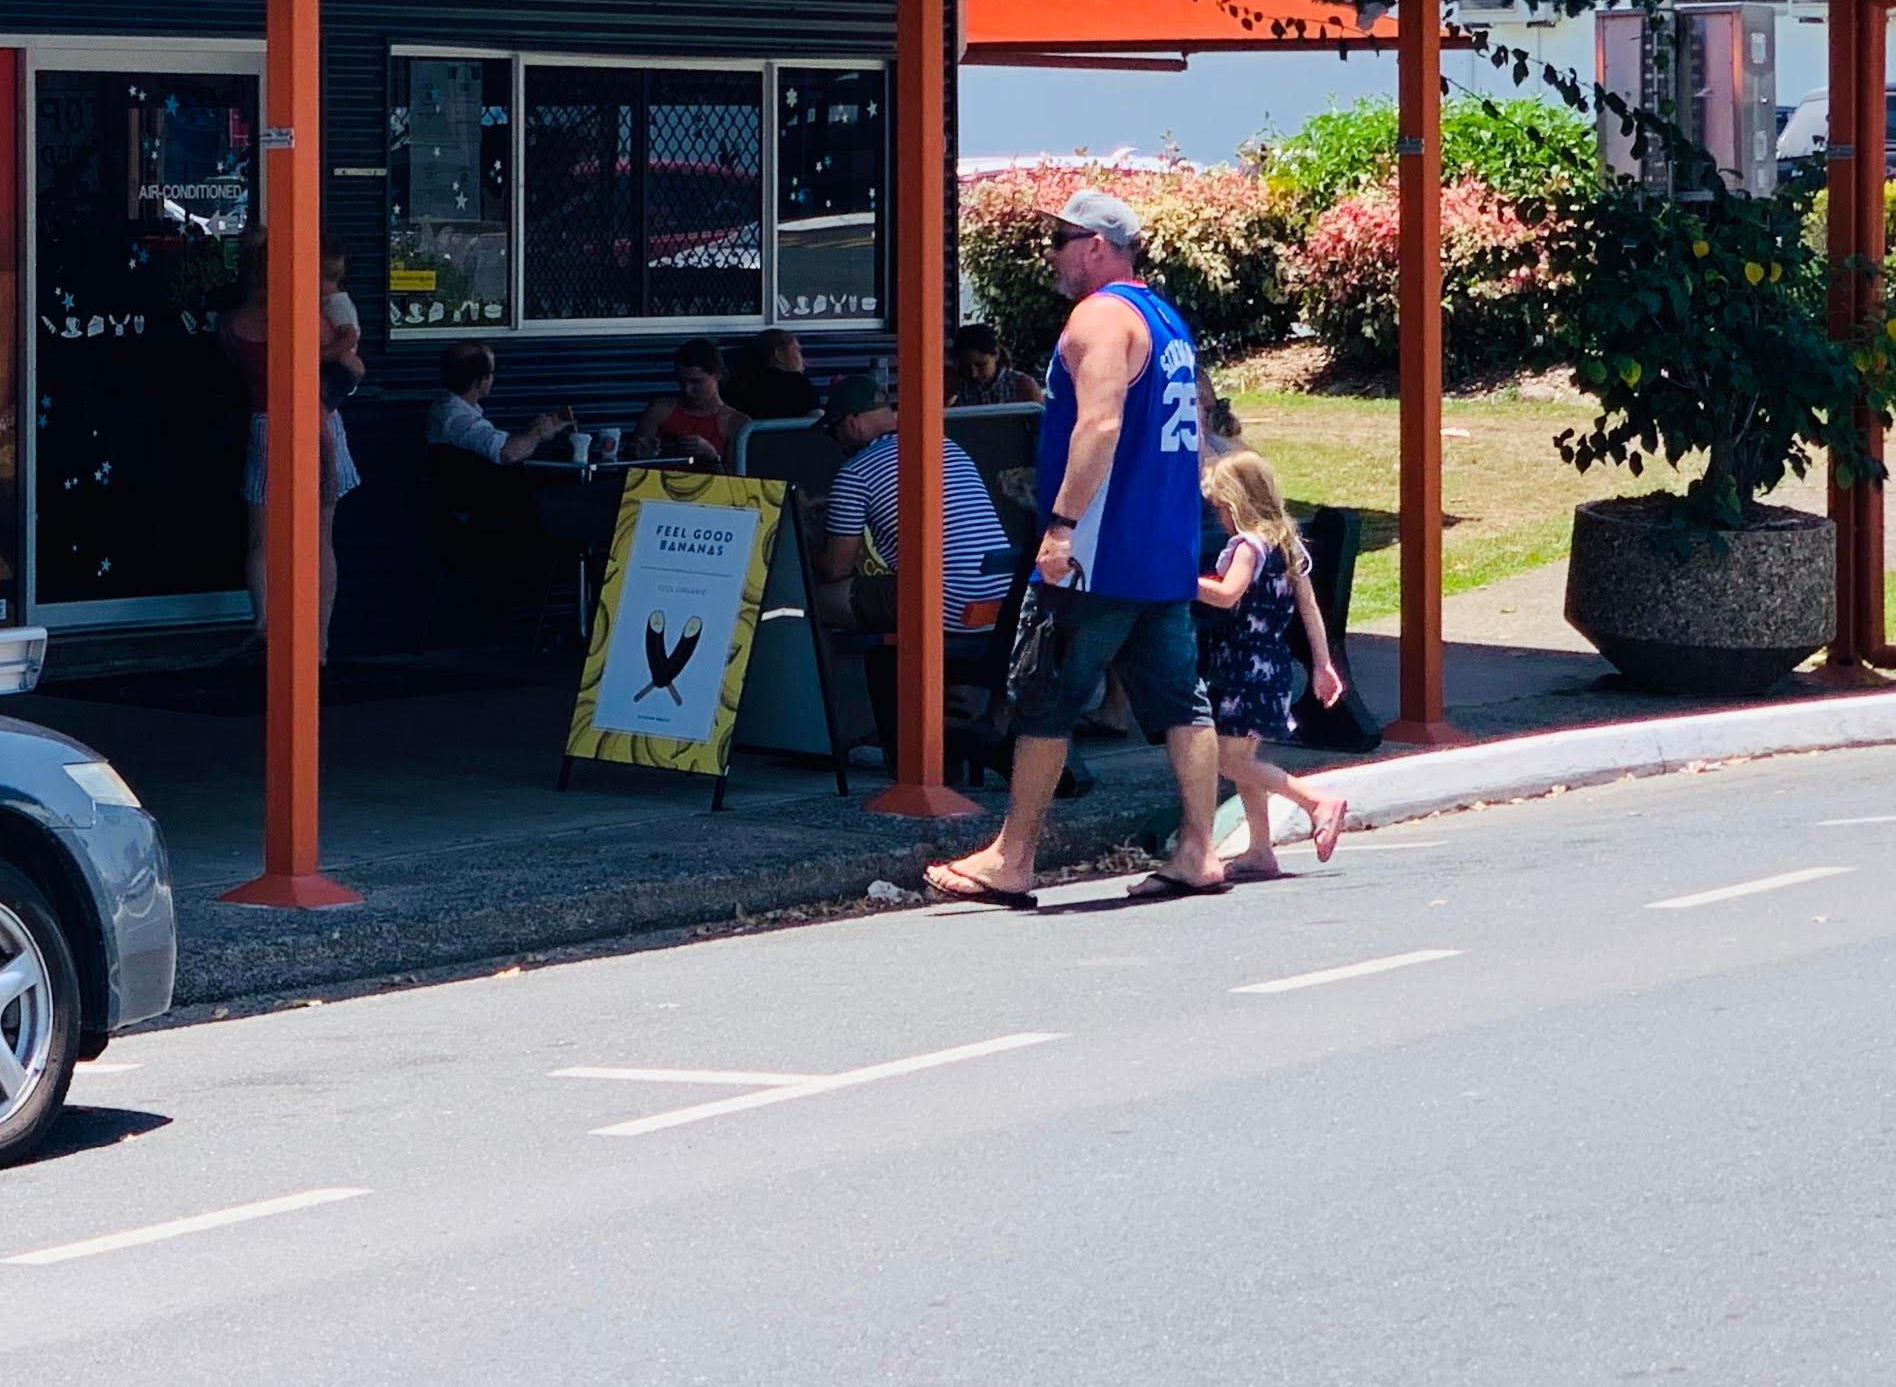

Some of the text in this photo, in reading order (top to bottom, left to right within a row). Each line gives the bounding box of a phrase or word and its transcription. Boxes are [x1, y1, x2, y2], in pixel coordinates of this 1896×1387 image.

[138, 184, 242, 201] AIR-CONDITIONED
[1160, 382, 1199, 452] 25
[656, 524, 733, 543] FEEL GOOD
[659, 539, 724, 556] BANANAS
